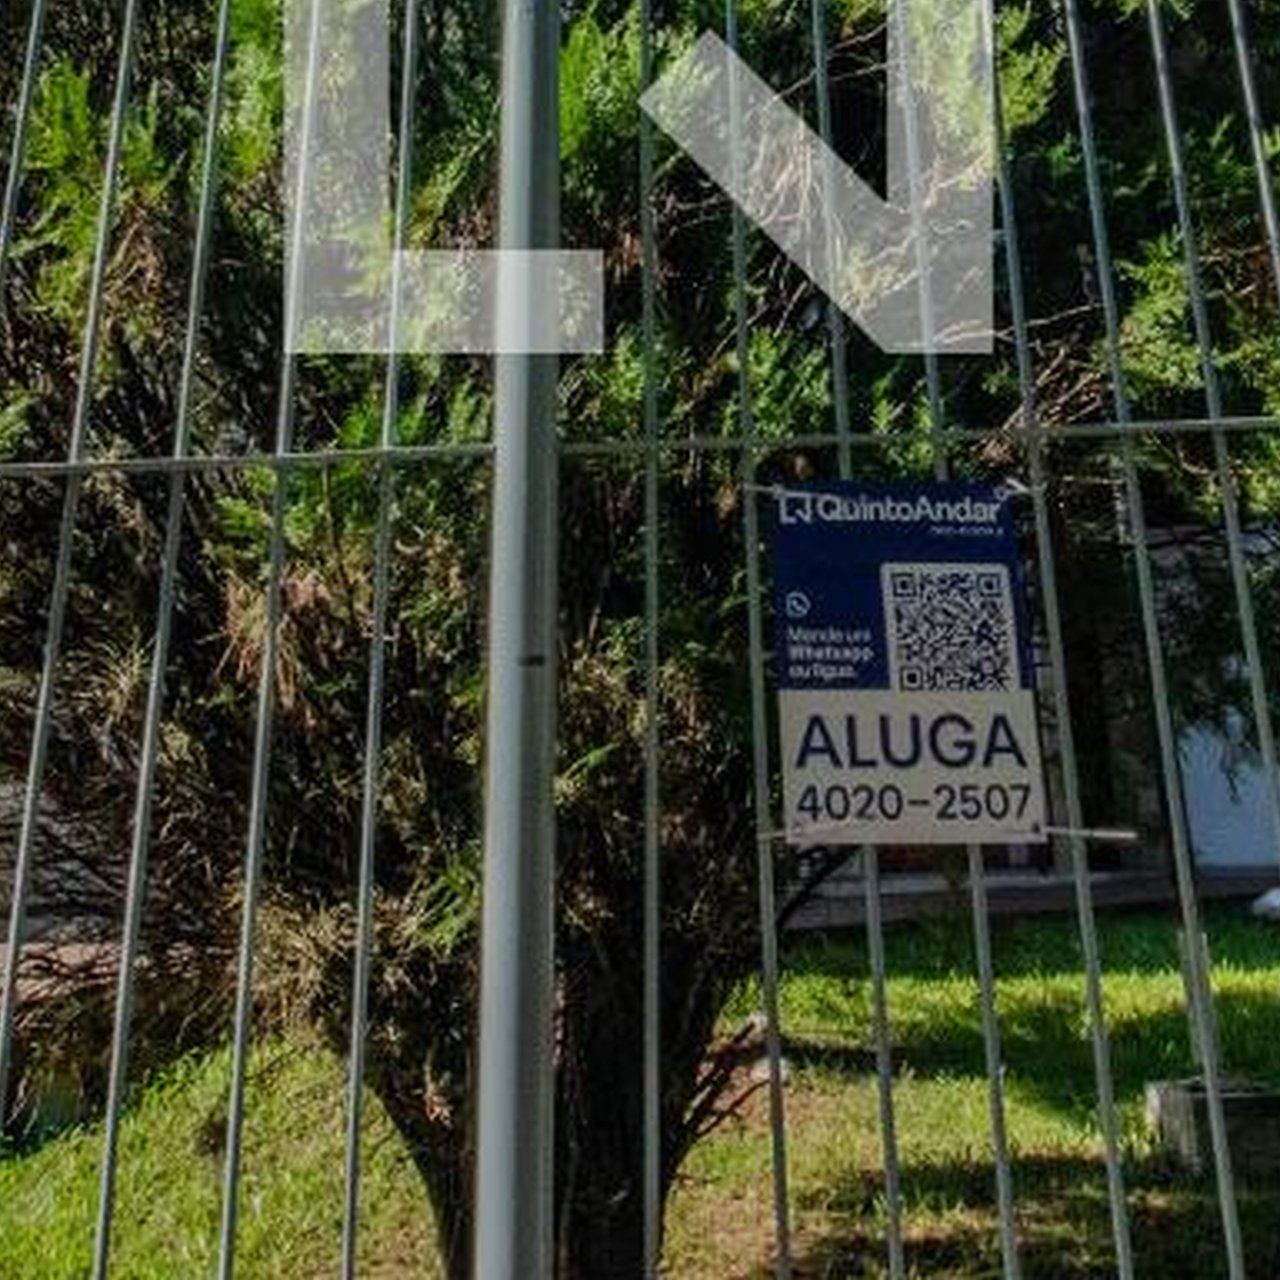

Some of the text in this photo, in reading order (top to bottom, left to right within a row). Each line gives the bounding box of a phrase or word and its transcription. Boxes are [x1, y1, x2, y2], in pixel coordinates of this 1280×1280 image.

[817, 494, 1000, 522] QuintoAndar
[796, 714, 1027, 768] ALUGA
[797, 784, 1031, 821] 4020-2507
